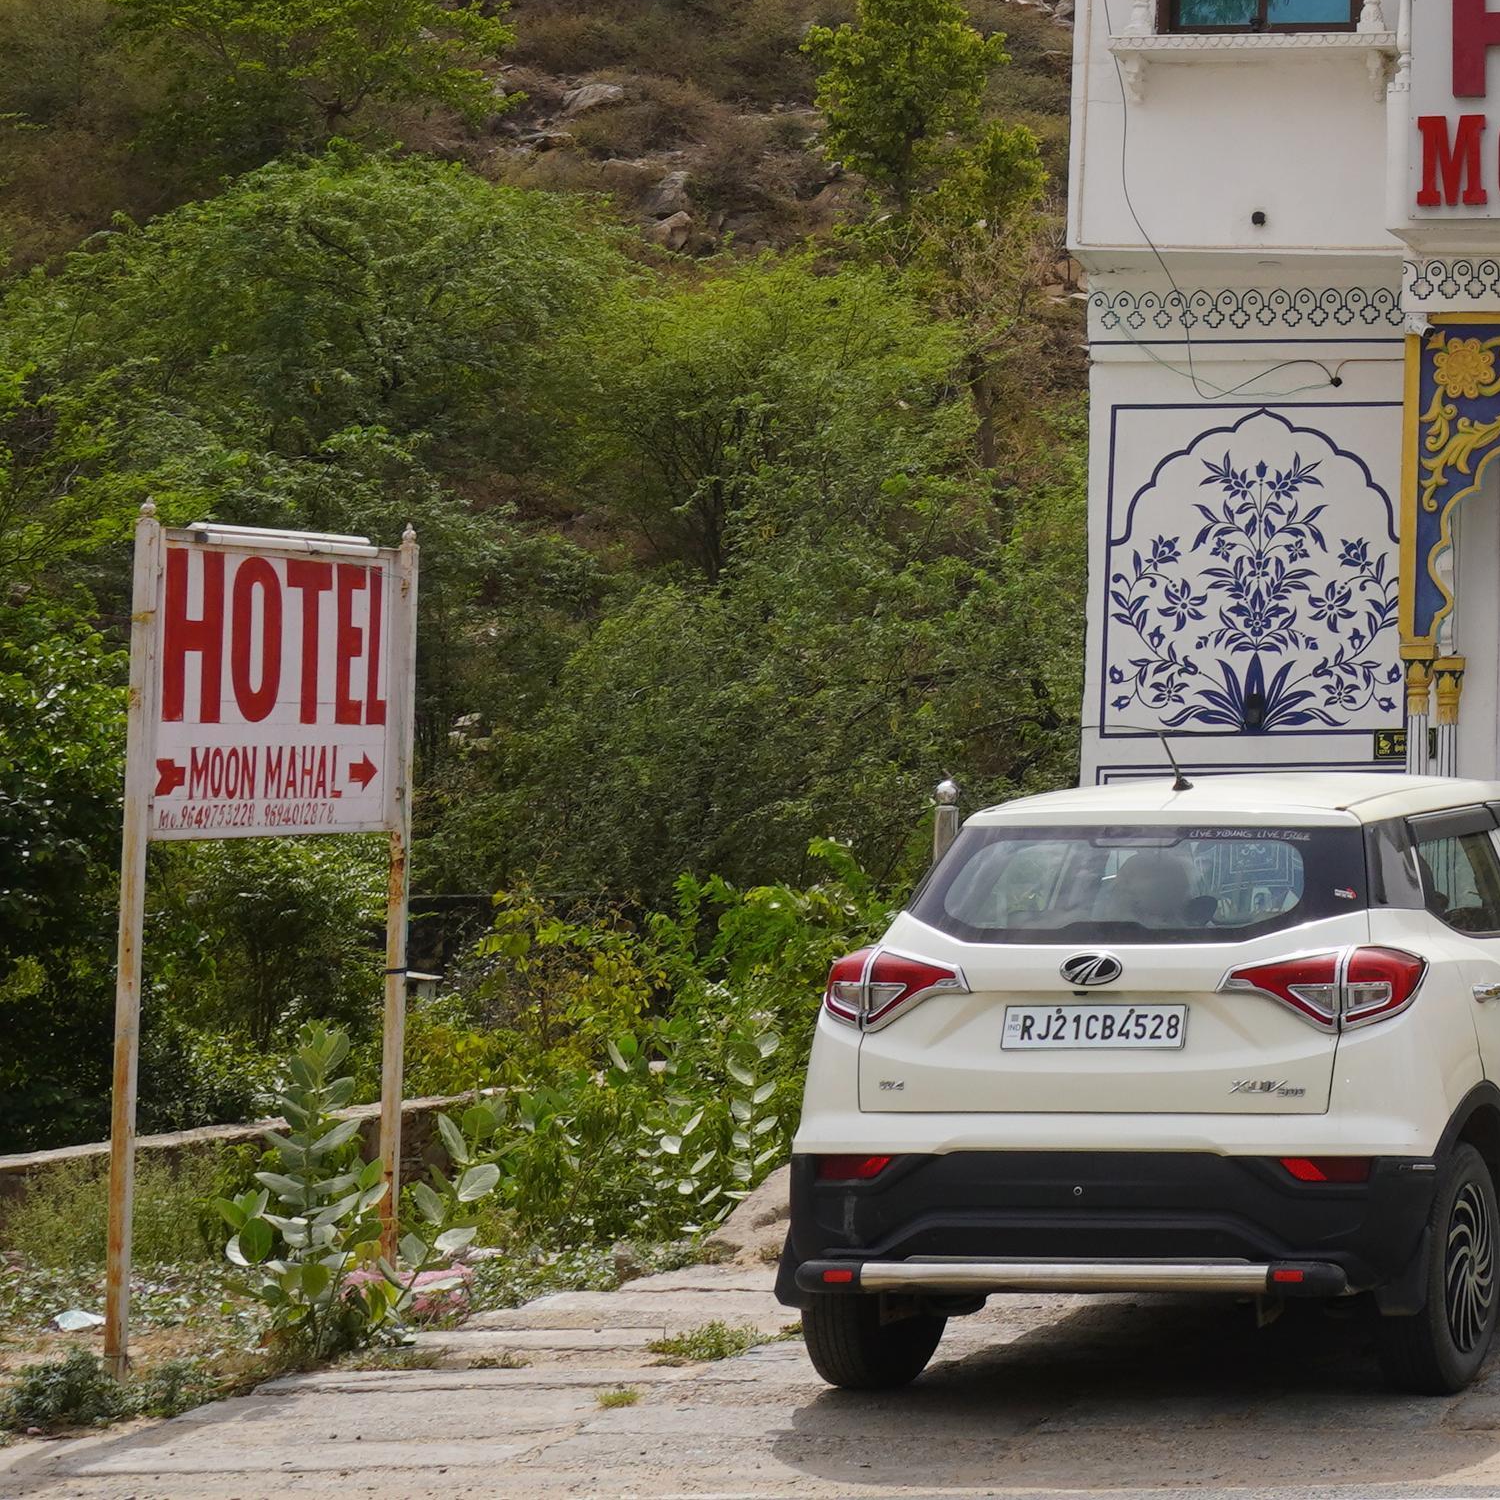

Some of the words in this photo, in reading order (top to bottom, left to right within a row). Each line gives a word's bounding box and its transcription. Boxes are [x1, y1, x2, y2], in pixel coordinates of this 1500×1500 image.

[162, 548, 386, 725] HOTEL
[189, 746, 257, 800] MOON
[264, 745, 342, 799] MAHAL
[1190, 829, 1212, 838] LIVE
[1257, 829, 1280, 838] LIVE
[1020, 1013, 1180, 1040] RJ21CB4528
